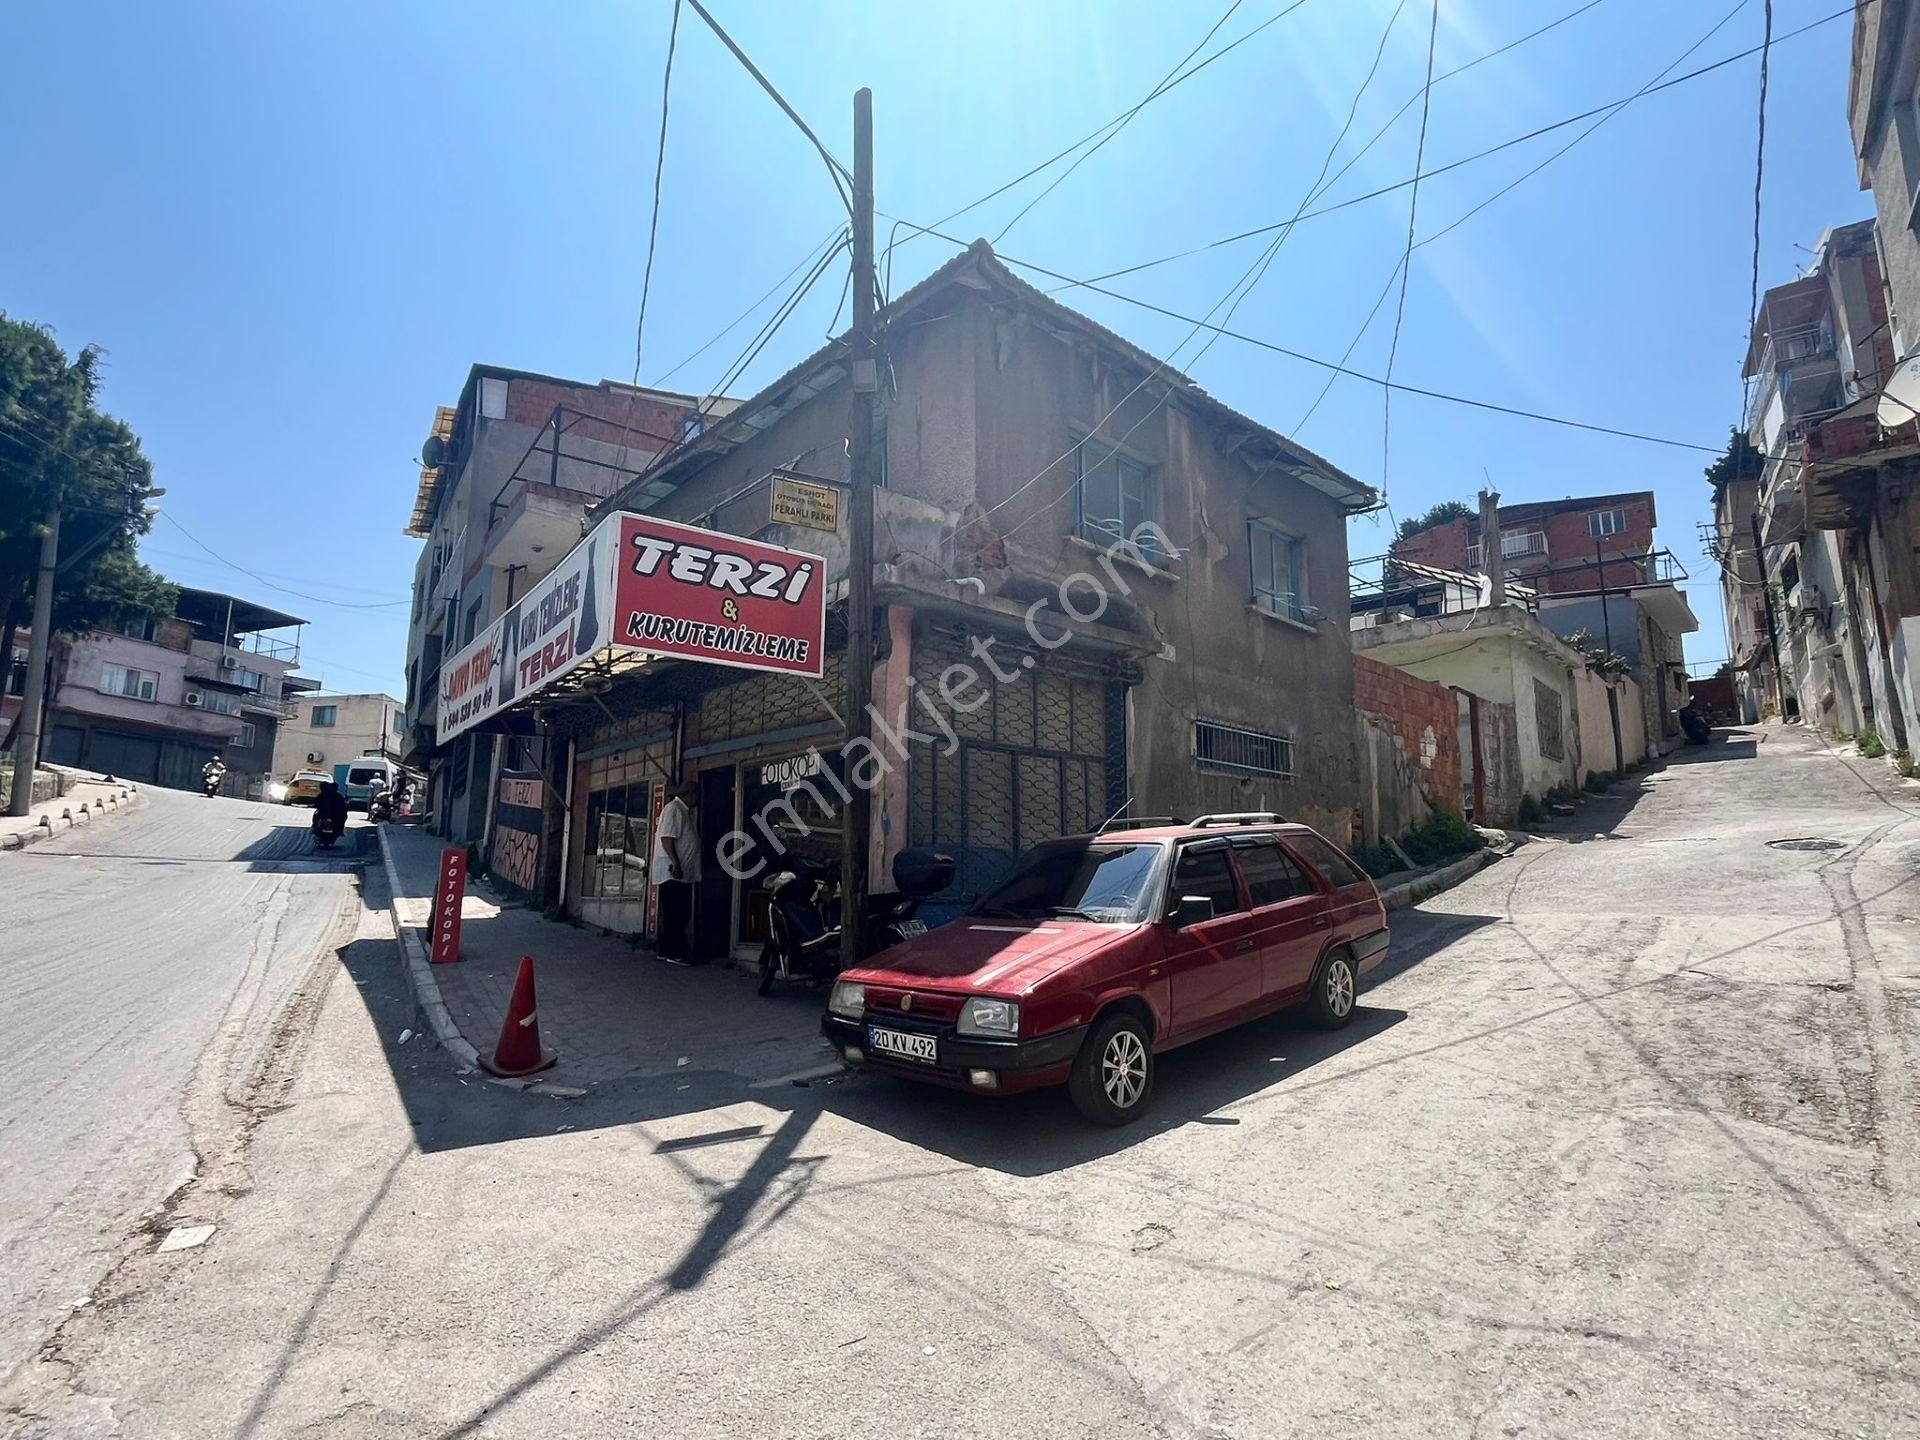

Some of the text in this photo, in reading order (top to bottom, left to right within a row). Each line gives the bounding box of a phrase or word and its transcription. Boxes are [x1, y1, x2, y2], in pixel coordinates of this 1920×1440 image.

[798, 489, 826, 499] ESHOT
[775, 504, 809, 518] FERAHLI
[633, 535, 811, 603] TERZİ
[722, 598, 739, 621] &
[627, 611, 809, 663] KURUTEMİZLEME
[875, 1031, 889, 1047] 20
[892, 1034, 907, 1051] KV
[912, 1038, 935, 1057] 492
